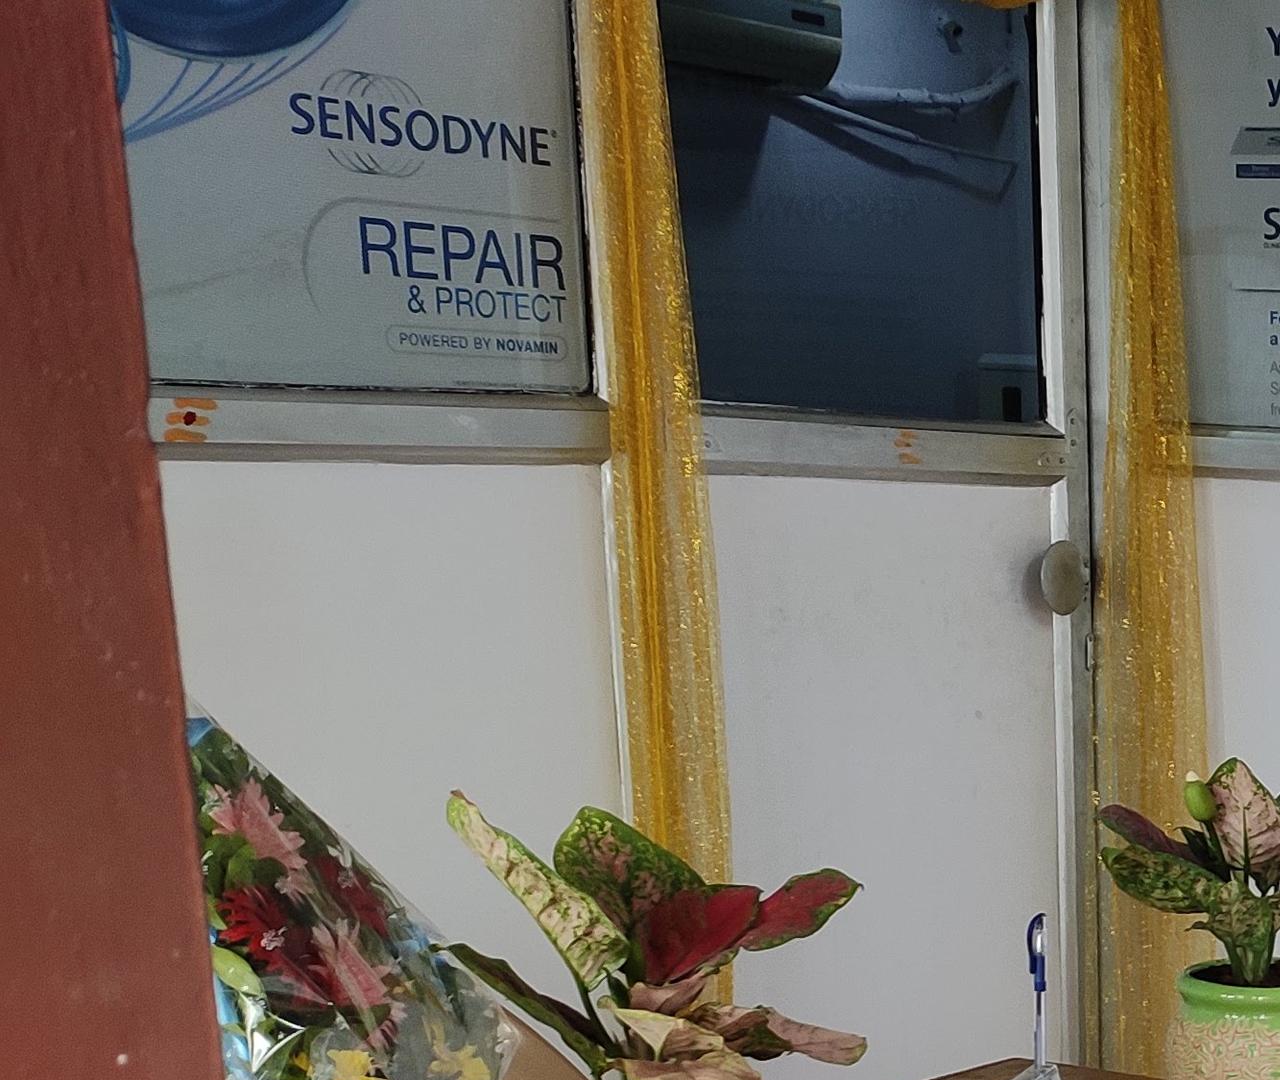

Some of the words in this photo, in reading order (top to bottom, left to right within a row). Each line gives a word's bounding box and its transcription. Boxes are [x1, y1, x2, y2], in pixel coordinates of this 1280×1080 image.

[289, 93, 551, 167] SENSODYNE
[359, 216, 566, 290] REPAIR
[408, 285, 426, 314] &
[435, 287, 567, 323] PROTECT
[399, 333, 468, 348] POWERED
[474, 335, 491, 350] BY
[497, 337, 558, 354] NOVAMIN
[1270, 334, 1278, 346] a
